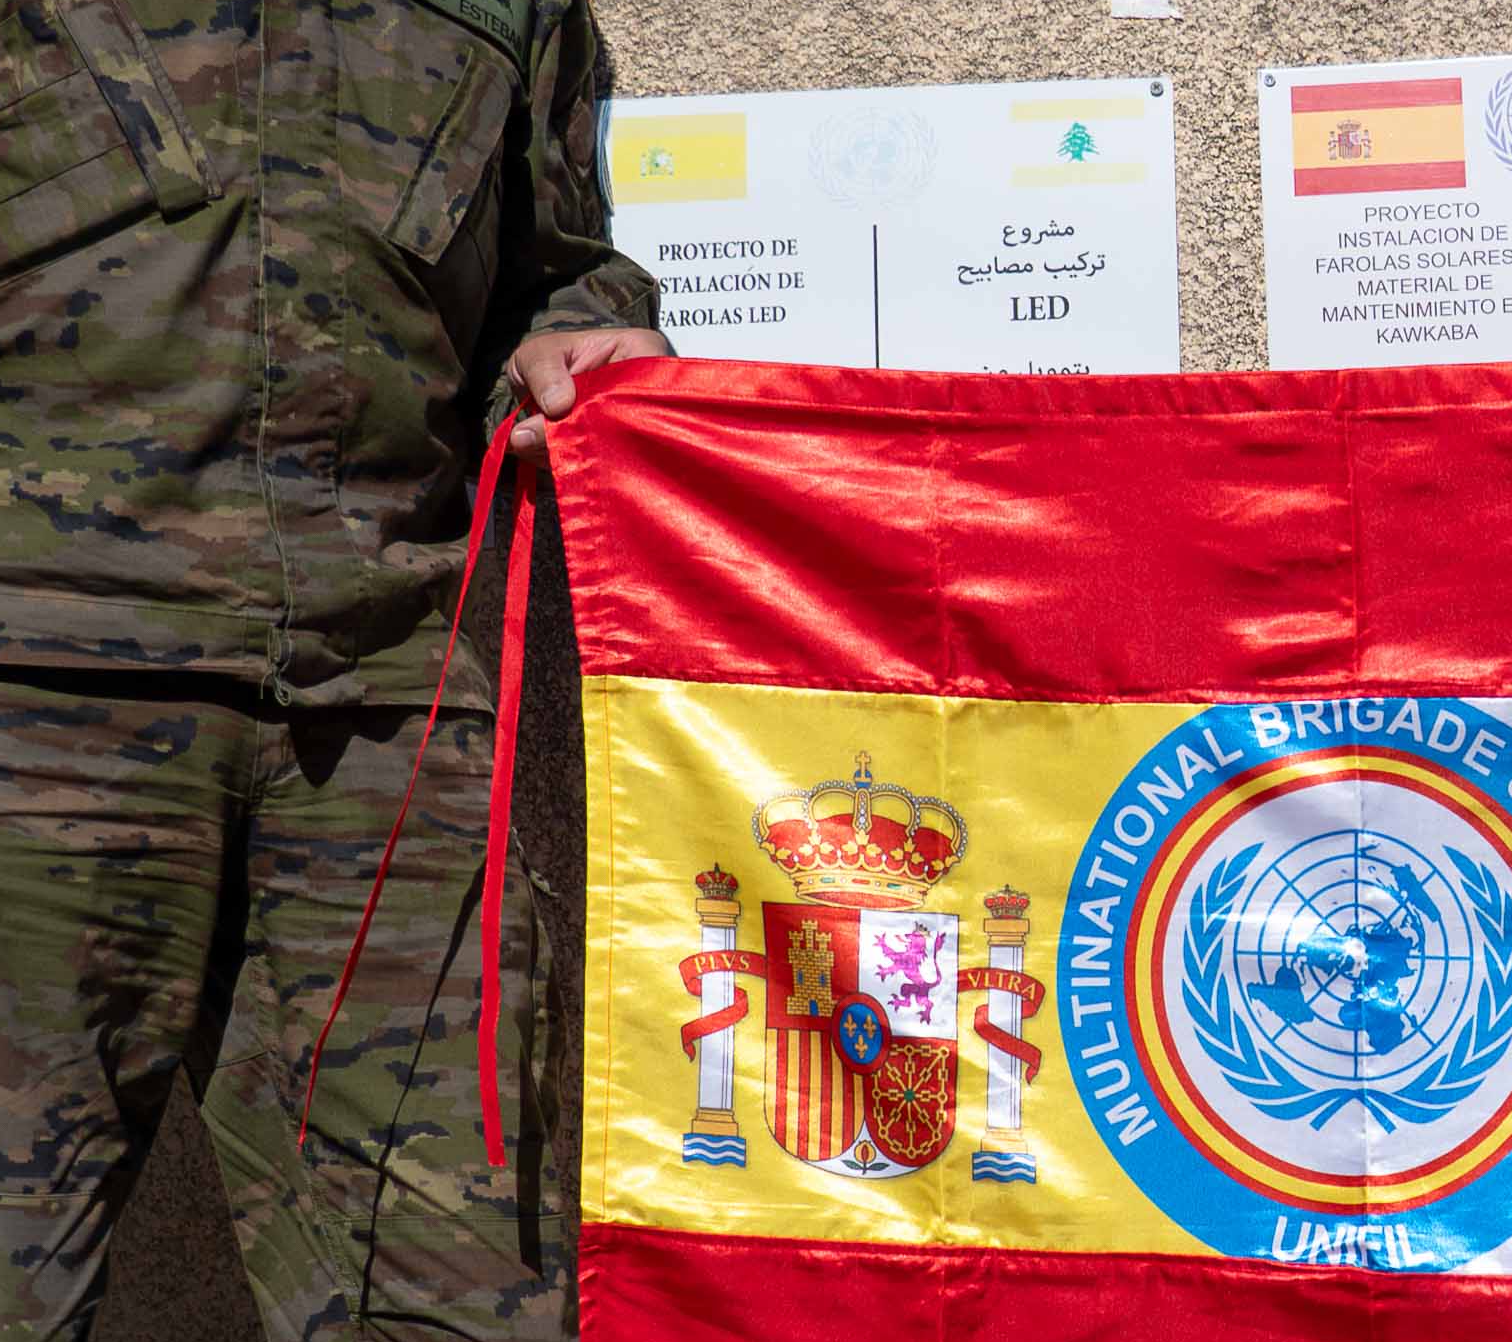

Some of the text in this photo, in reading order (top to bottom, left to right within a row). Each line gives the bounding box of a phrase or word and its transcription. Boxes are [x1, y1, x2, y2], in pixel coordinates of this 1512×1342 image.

[1364, 202, 1480, 223] PROYECTO
[1002, 219, 1075, 247] مشروع
[1338, 225, 1509, 249] INSTALACION DE
[658, 239, 799, 261] PROYECTO DE
[957, 251, 1106, 286] تركيب مصابيح
[1315, 253, 1411, 275] FAROLAS
[660, 265, 805, 294] STALACIÓN DE
[1357, 274, 1493, 297] MATERIAL DE
[749, 306, 786, 324] LED
[1010, 295, 1070, 321] LED
[1322, 298, 1496, 323] MANTENIMIENTO
[1376, 323, 1479, 345] KAWKABA
[1067, 726, 1245, 1148] MULTINATIONAL
[1249, 697, 1507, 778] BRIGADE
[1269, 1214, 1437, 1269] UNIFIL
